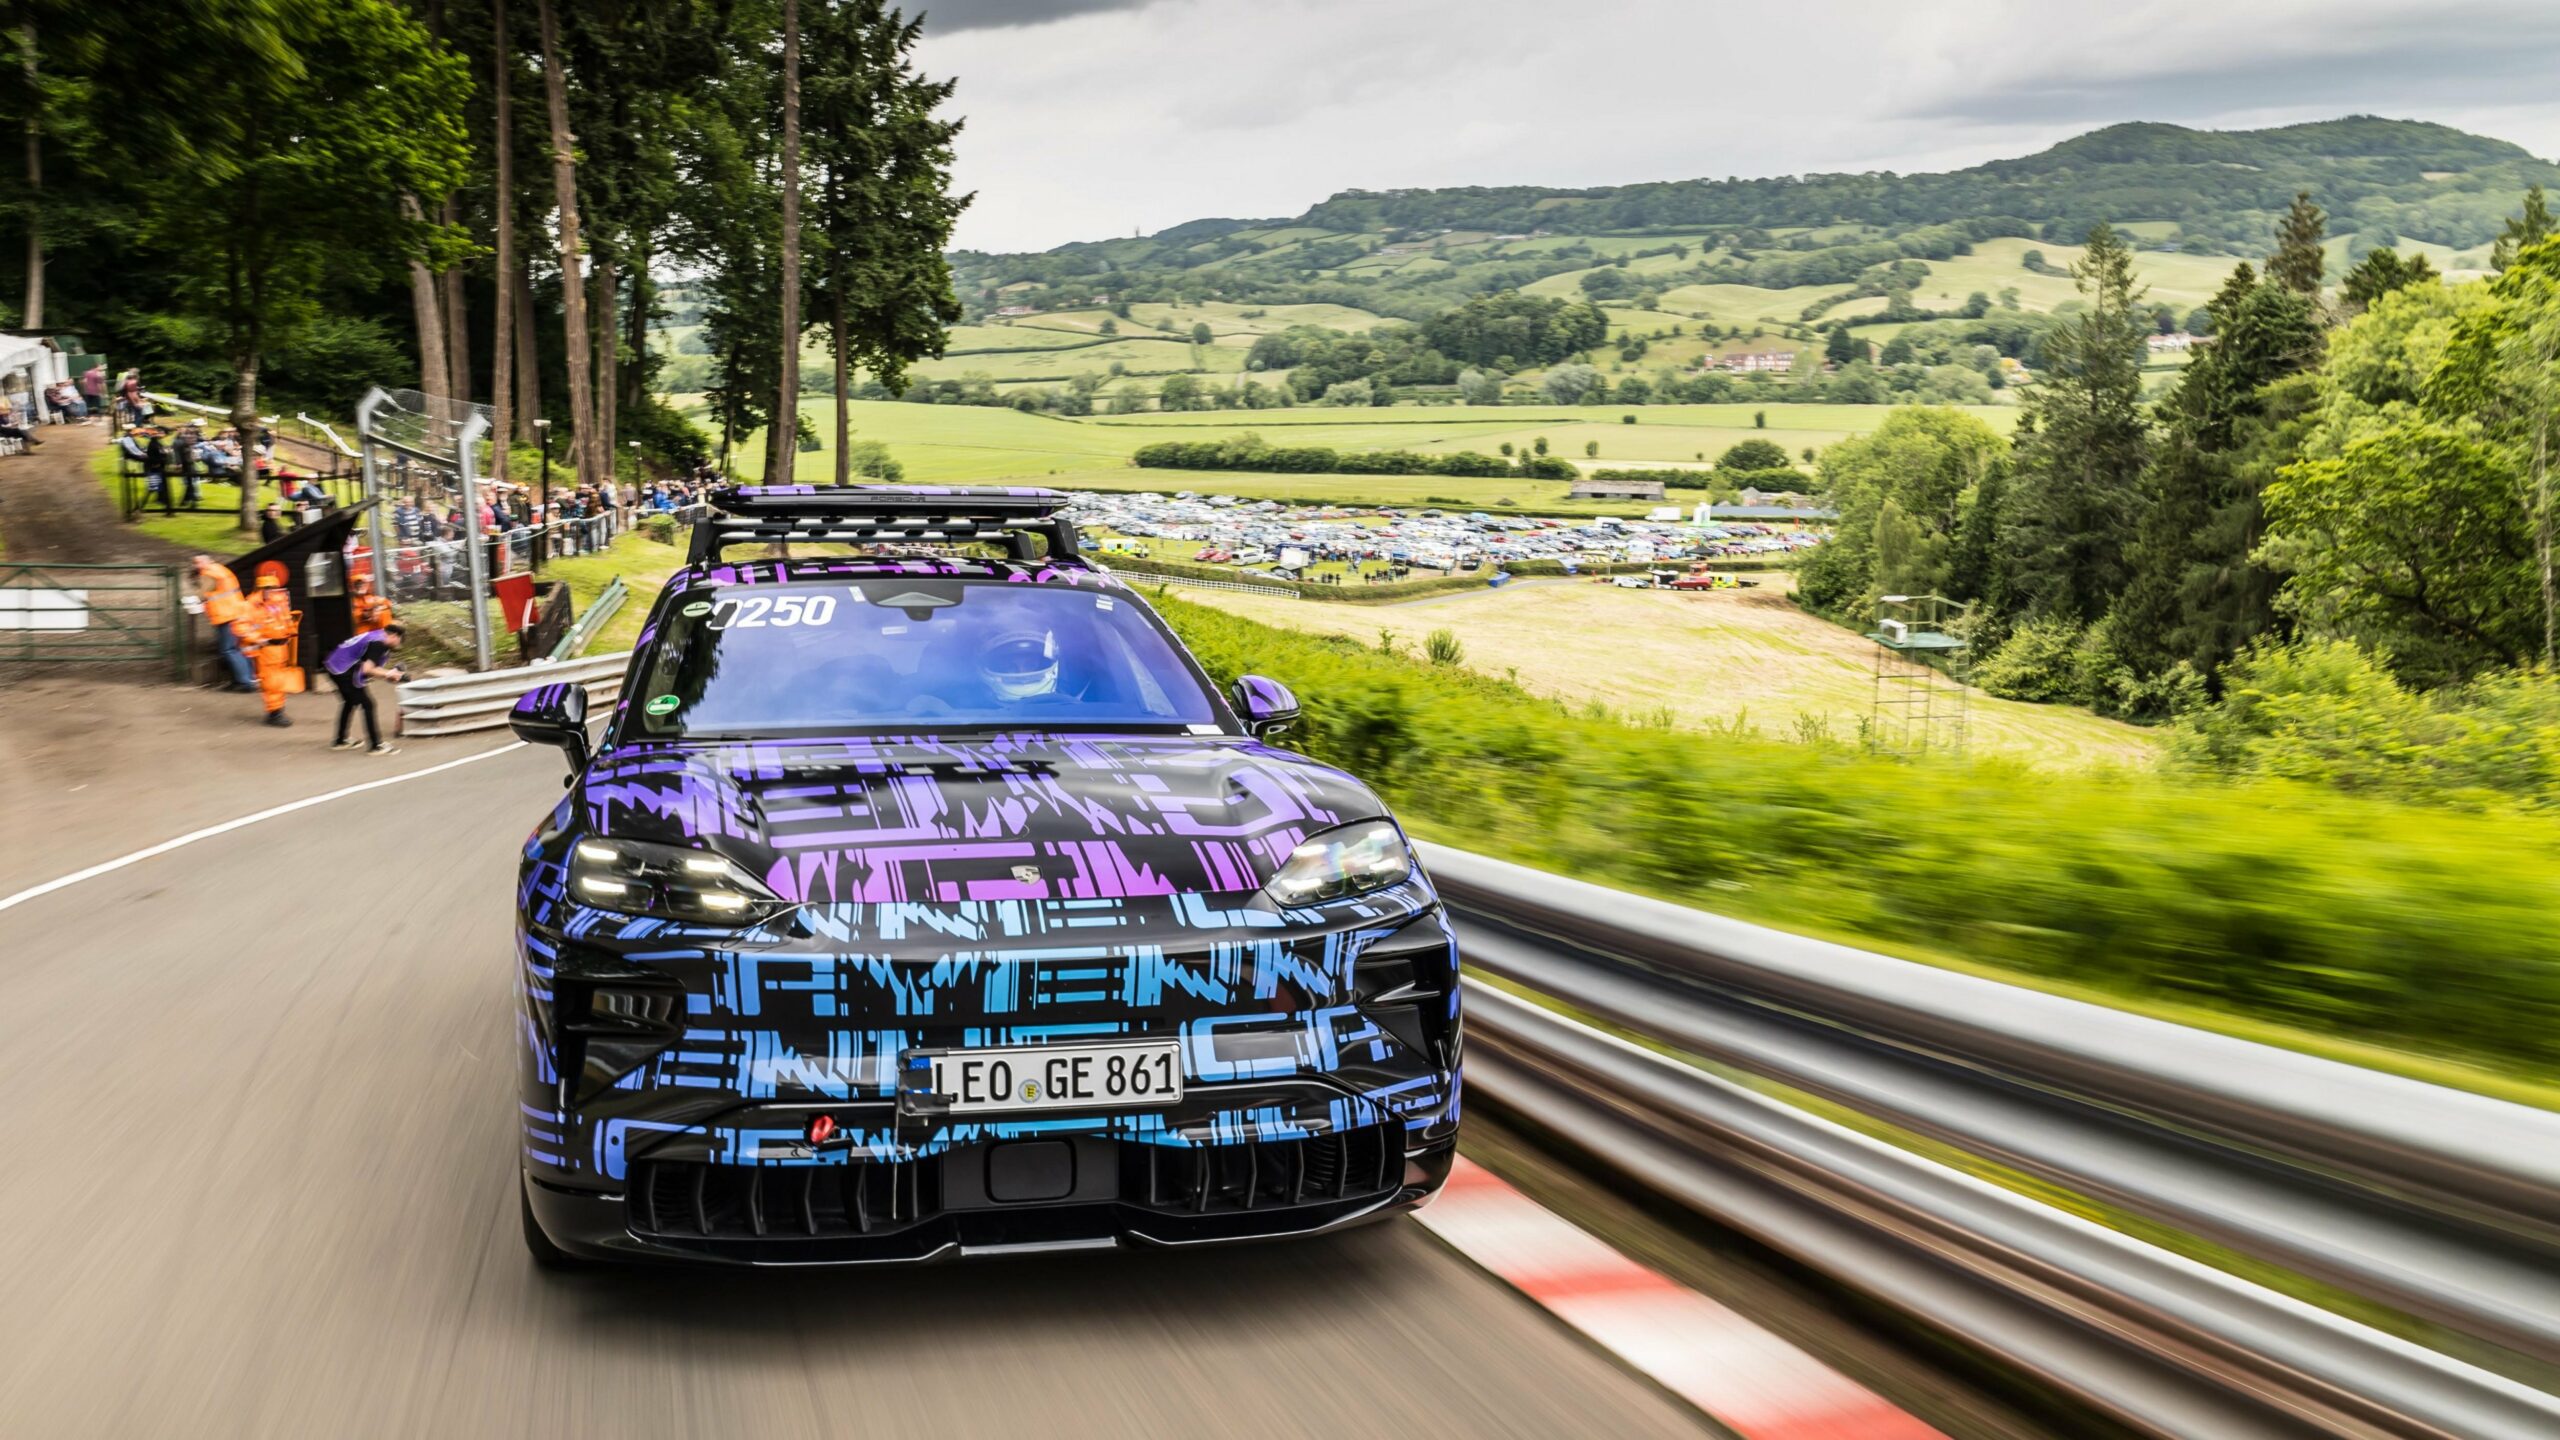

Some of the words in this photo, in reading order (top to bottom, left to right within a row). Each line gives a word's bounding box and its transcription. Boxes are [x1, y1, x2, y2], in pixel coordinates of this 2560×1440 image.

[935, 1060, 1012, 1104] LEO
[1045, 1057, 1094, 1099] GE
[1106, 1053, 1175, 1096] 861
